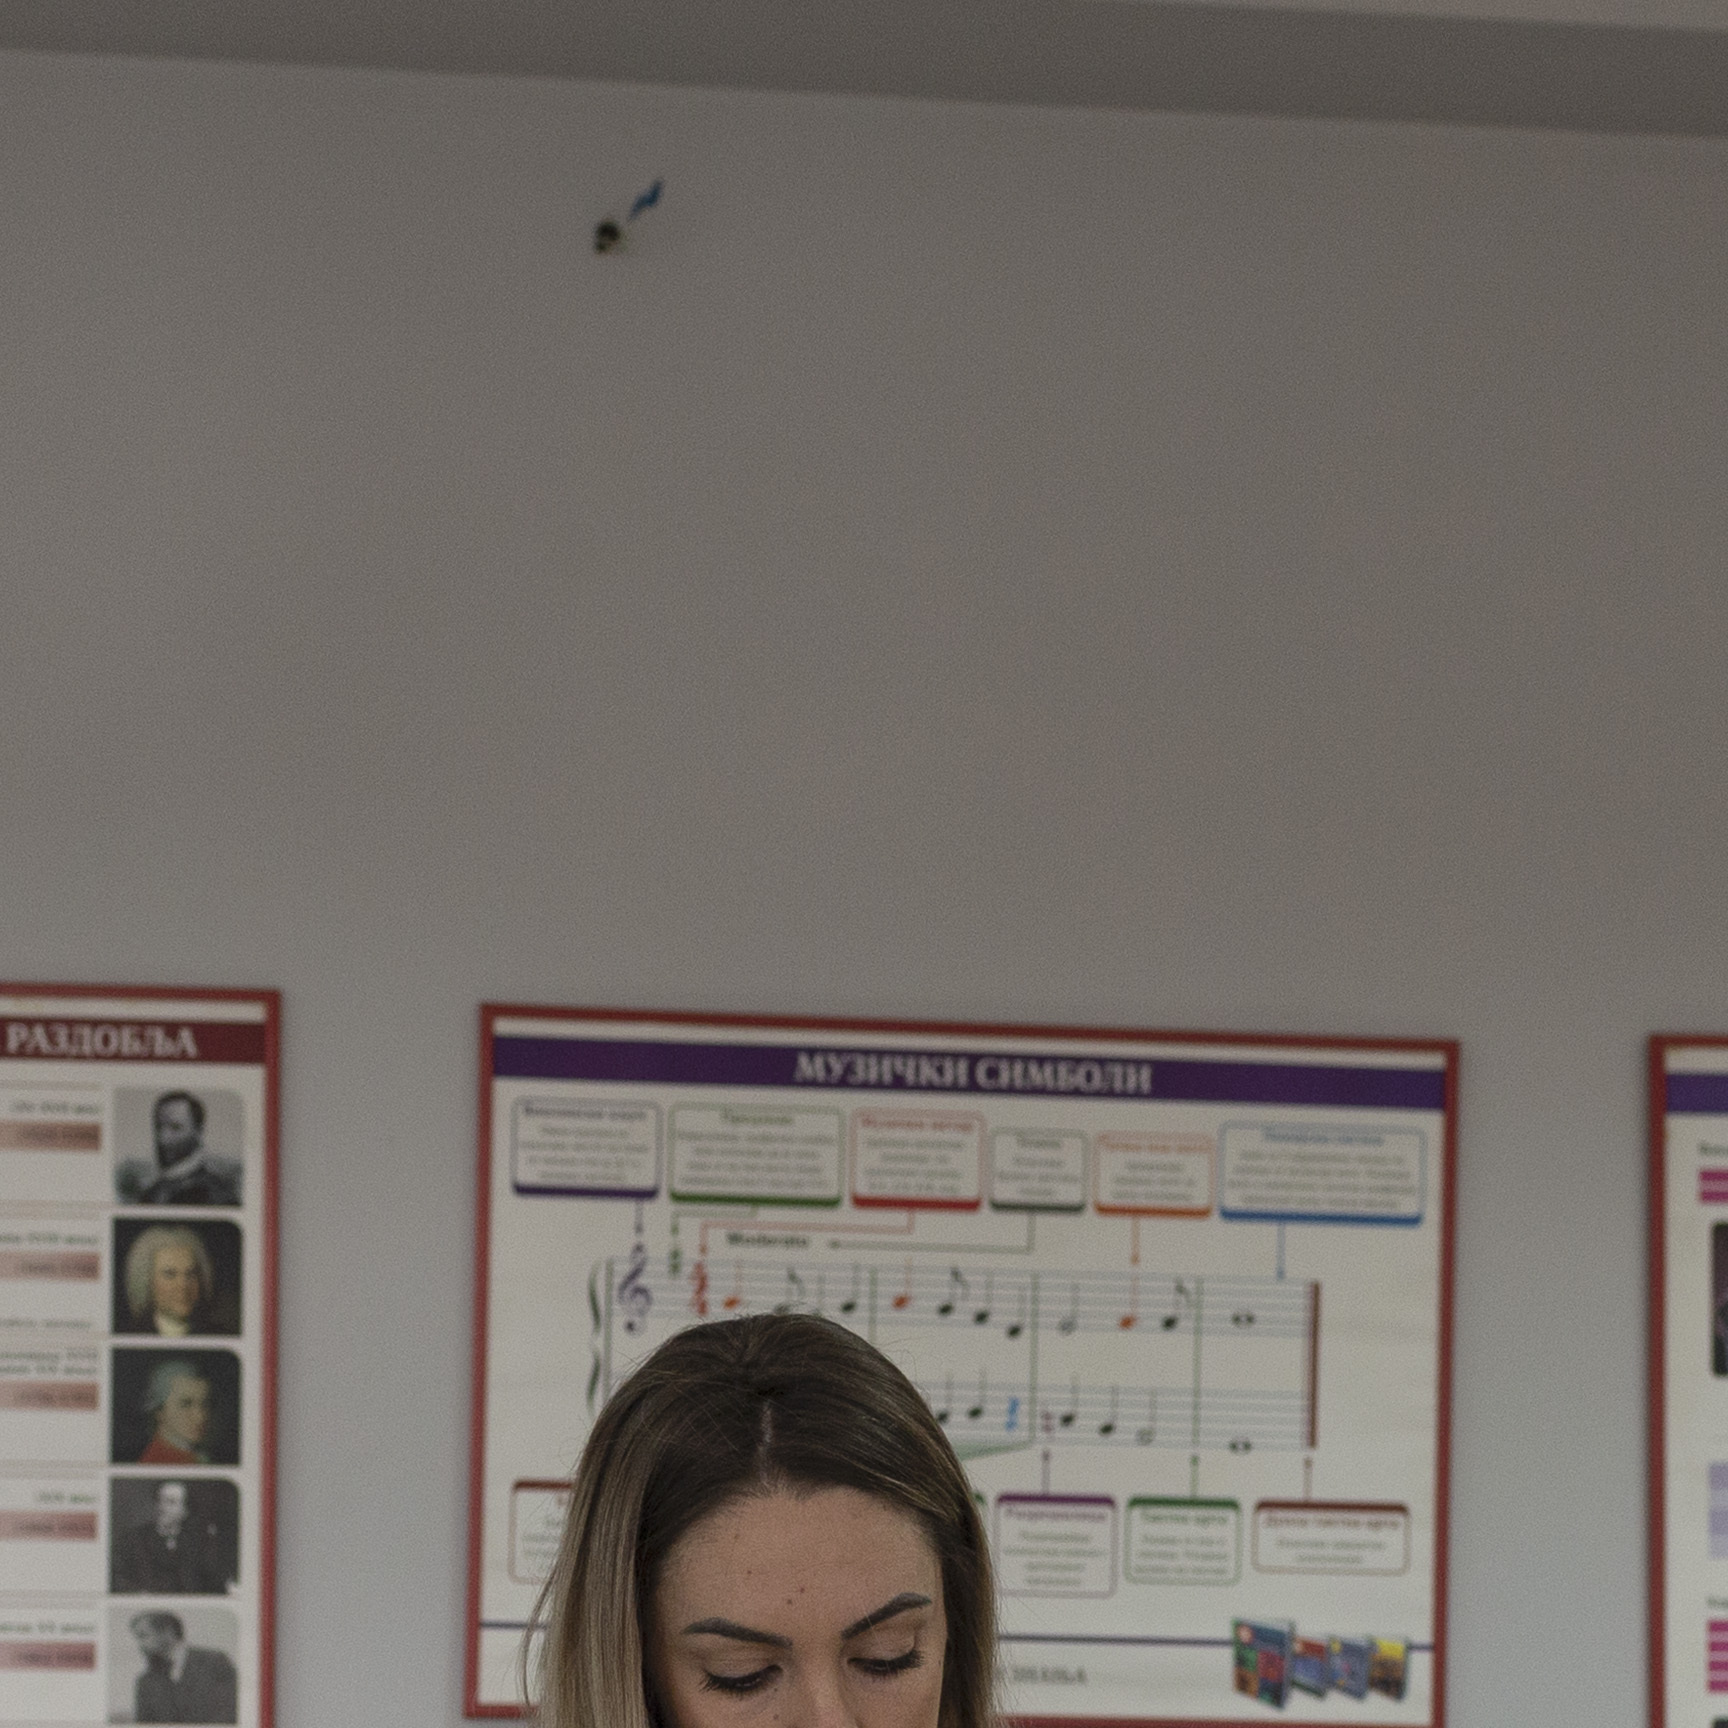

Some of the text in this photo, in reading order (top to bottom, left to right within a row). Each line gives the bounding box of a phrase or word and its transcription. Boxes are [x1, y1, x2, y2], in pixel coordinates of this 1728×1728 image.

[7, 1023, 198, 1060] РАЗДОБЉА
[793, 1052, 1153, 1096] МУЗИЧКИ СИМБОЛИ
